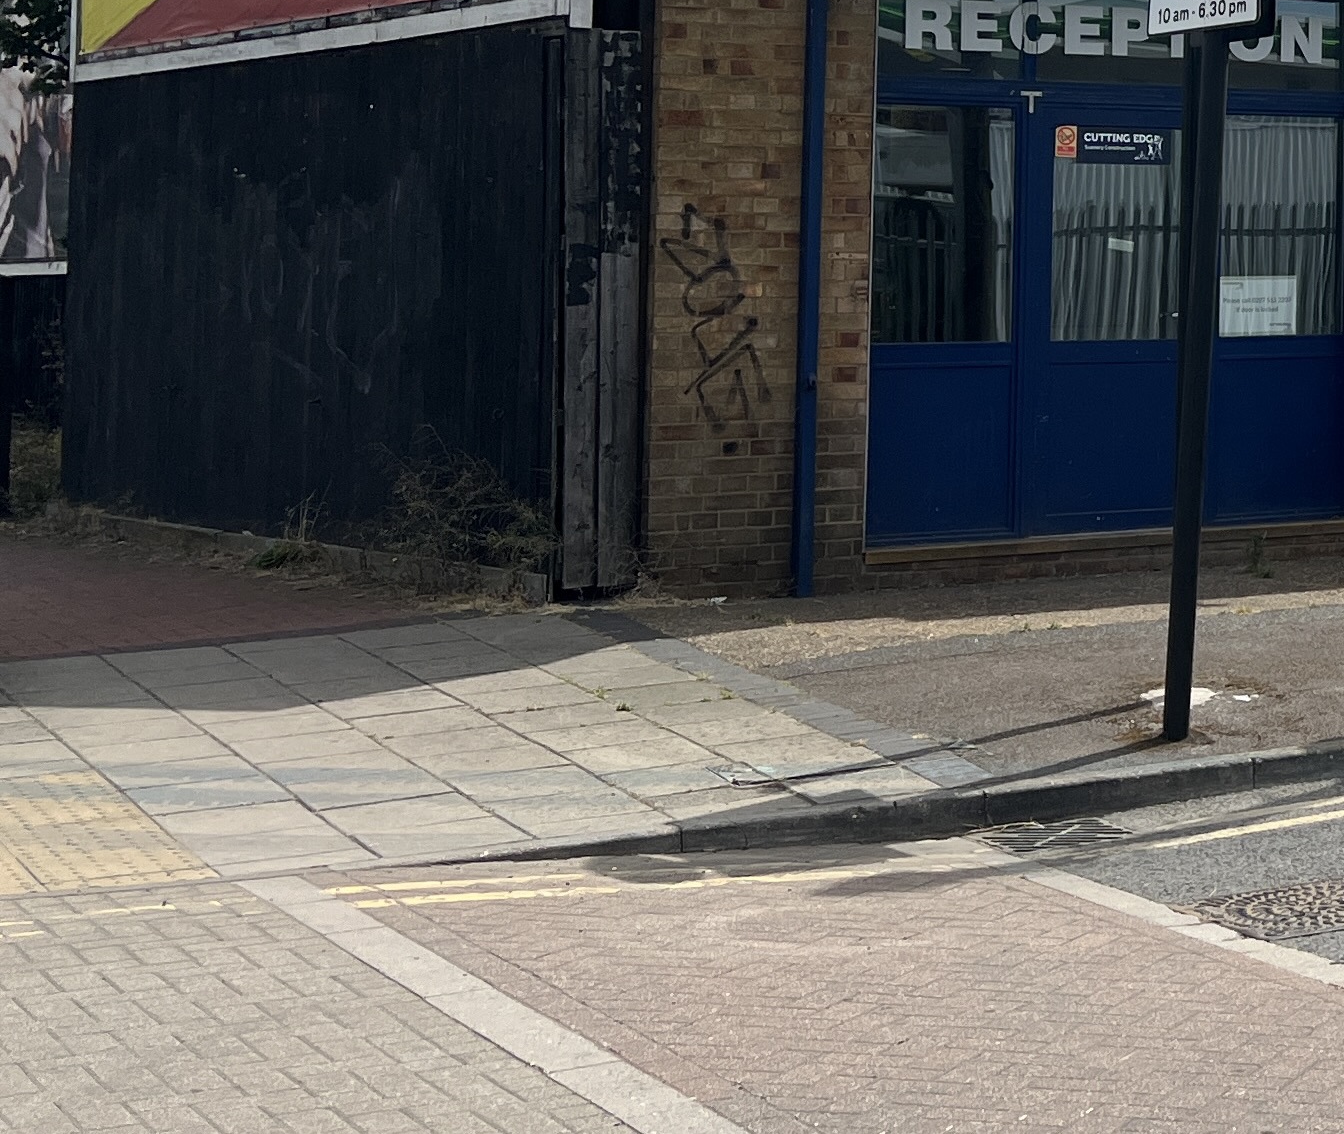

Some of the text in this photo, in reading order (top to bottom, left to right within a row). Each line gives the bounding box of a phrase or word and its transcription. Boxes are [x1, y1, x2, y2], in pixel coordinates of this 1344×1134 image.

[1158, 7, 1170, 24] 10
[1173, 7, 1189, 21] am
[1199, 0, 1226, 18] 6.30
[1229, 0, 1247, 18] pm
[1083, 132, 1131, 143] CUTTING
